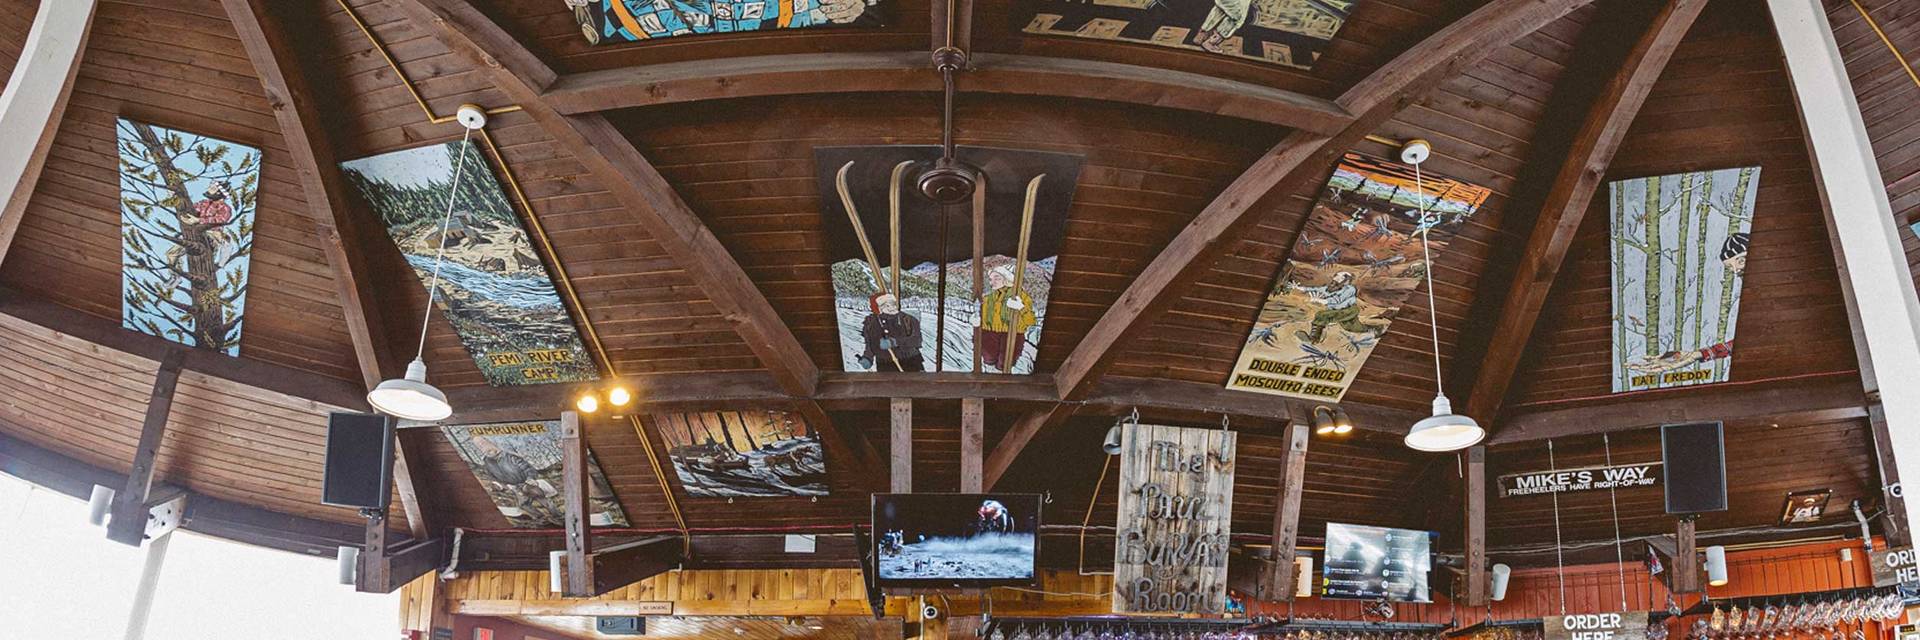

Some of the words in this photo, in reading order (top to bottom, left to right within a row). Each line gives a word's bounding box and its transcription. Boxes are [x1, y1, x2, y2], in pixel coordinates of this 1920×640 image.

[488, 354, 522, 366] PEMI
[527, 350, 572, 363] RIVER
[521, 367, 556, 379] CAMP
[1248, 359, 1300, 377] DOUBLE
[1302, 366, 1345, 382] ENDED
[1632, 375, 1656, 386] FAT
[1664, 369, 1712, 383] FREDDY
[1303, 383, 1345, 398] BEES!
[467, 423, 546, 435] RUMRUNNER
[1516, 470, 1592, 489] MIKE'S
[1603, 466, 1650, 482] WAY
[1508, 483, 1567, 496] FREEHEELERS
[1569, 482, 1591, 491] HAVE
[1594, 477, 1656, 489] RIGHT-OF-WAY
[1886, 549, 1916, 568] ORD
[1896, 566, 1918, 583] HE
[1563, 613, 1621, 630] ORDER
